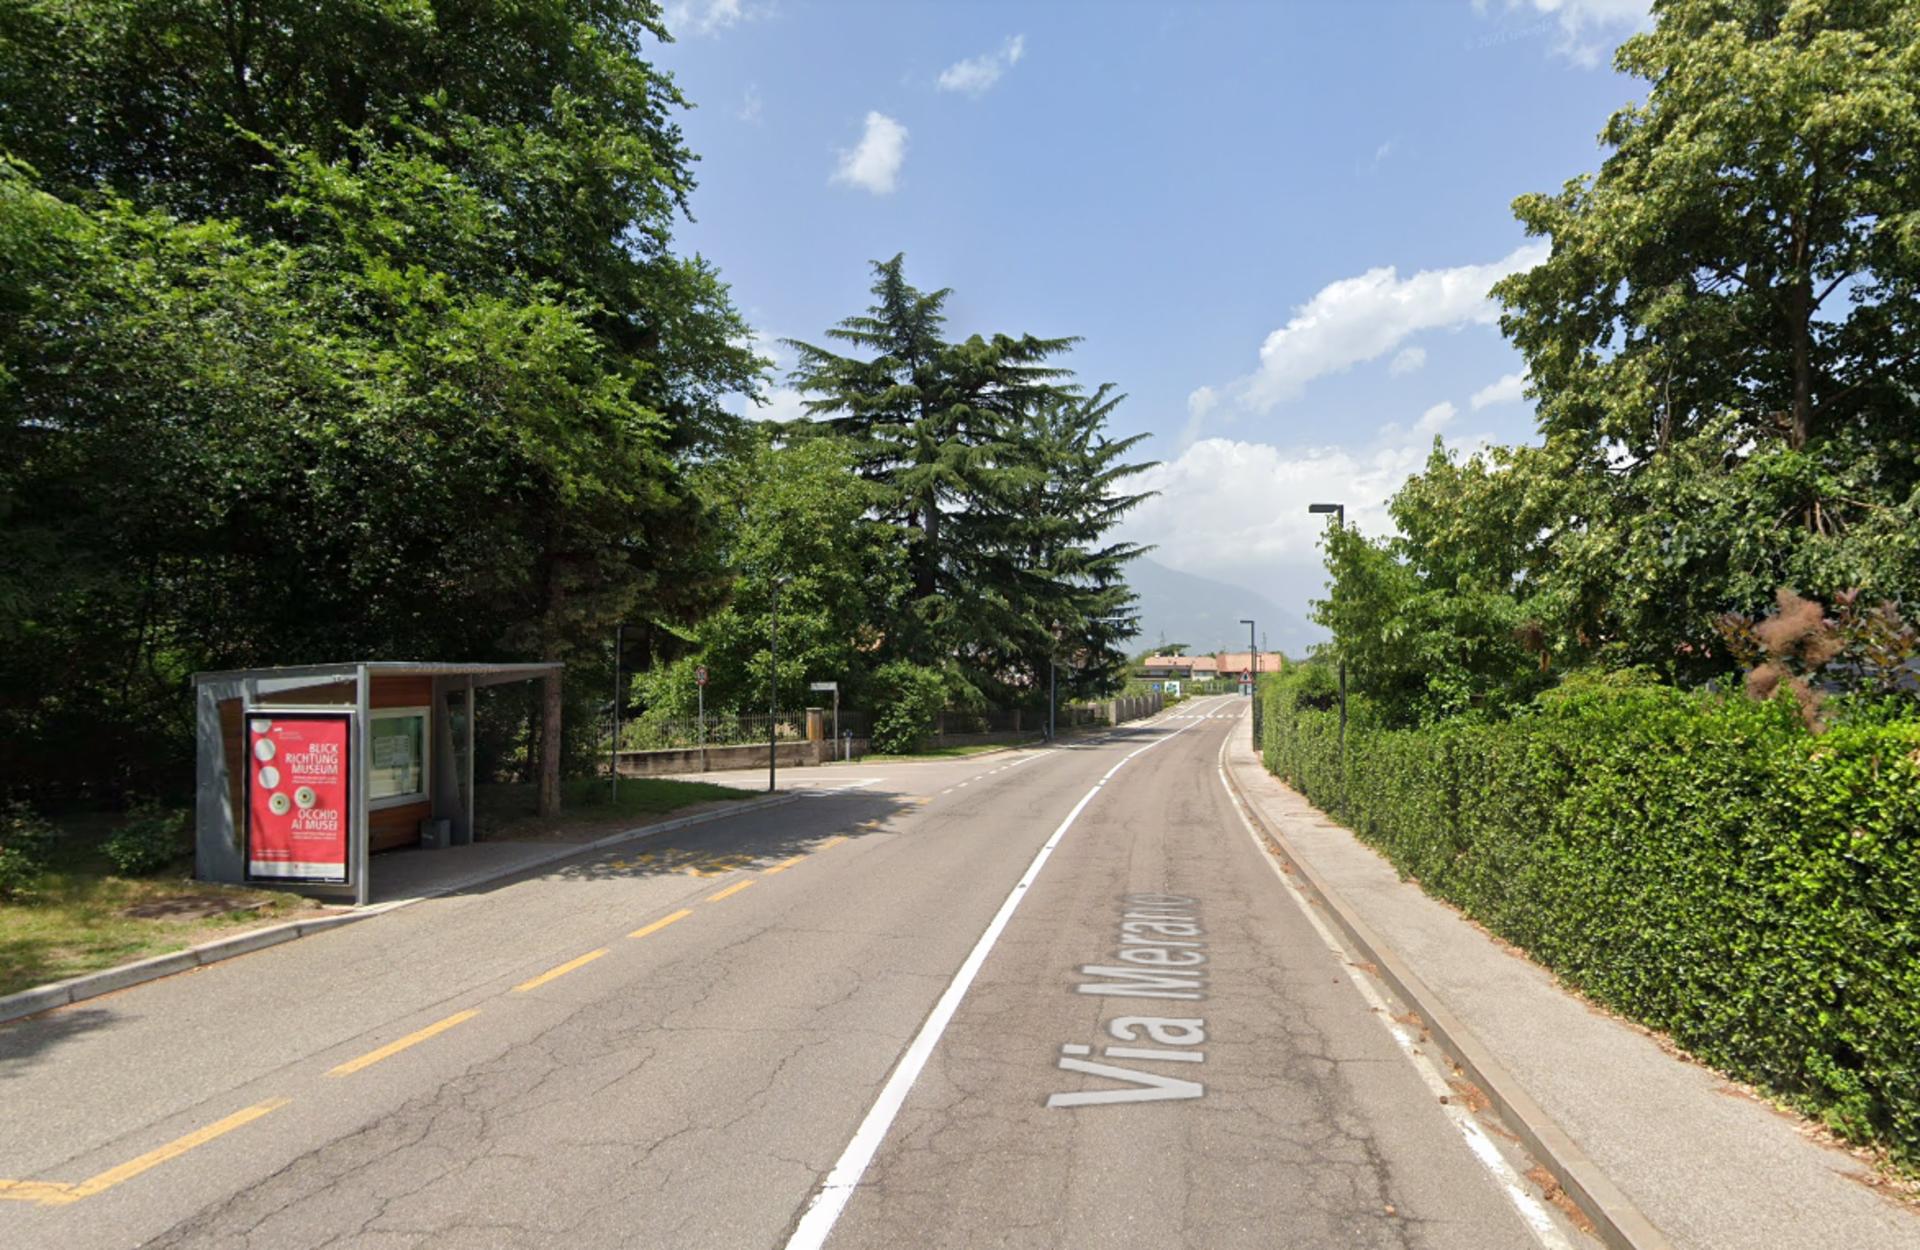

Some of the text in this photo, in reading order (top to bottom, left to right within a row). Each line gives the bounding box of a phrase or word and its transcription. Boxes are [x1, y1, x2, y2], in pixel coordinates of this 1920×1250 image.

[309, 743, 338, 753] BLICK
[285, 753, 338, 764] RICHTUNG
[291, 764, 338, 775] MUSEUM
[297, 808, 338, 820] OCCHIO
[305, 819, 338, 831] MUSEI
